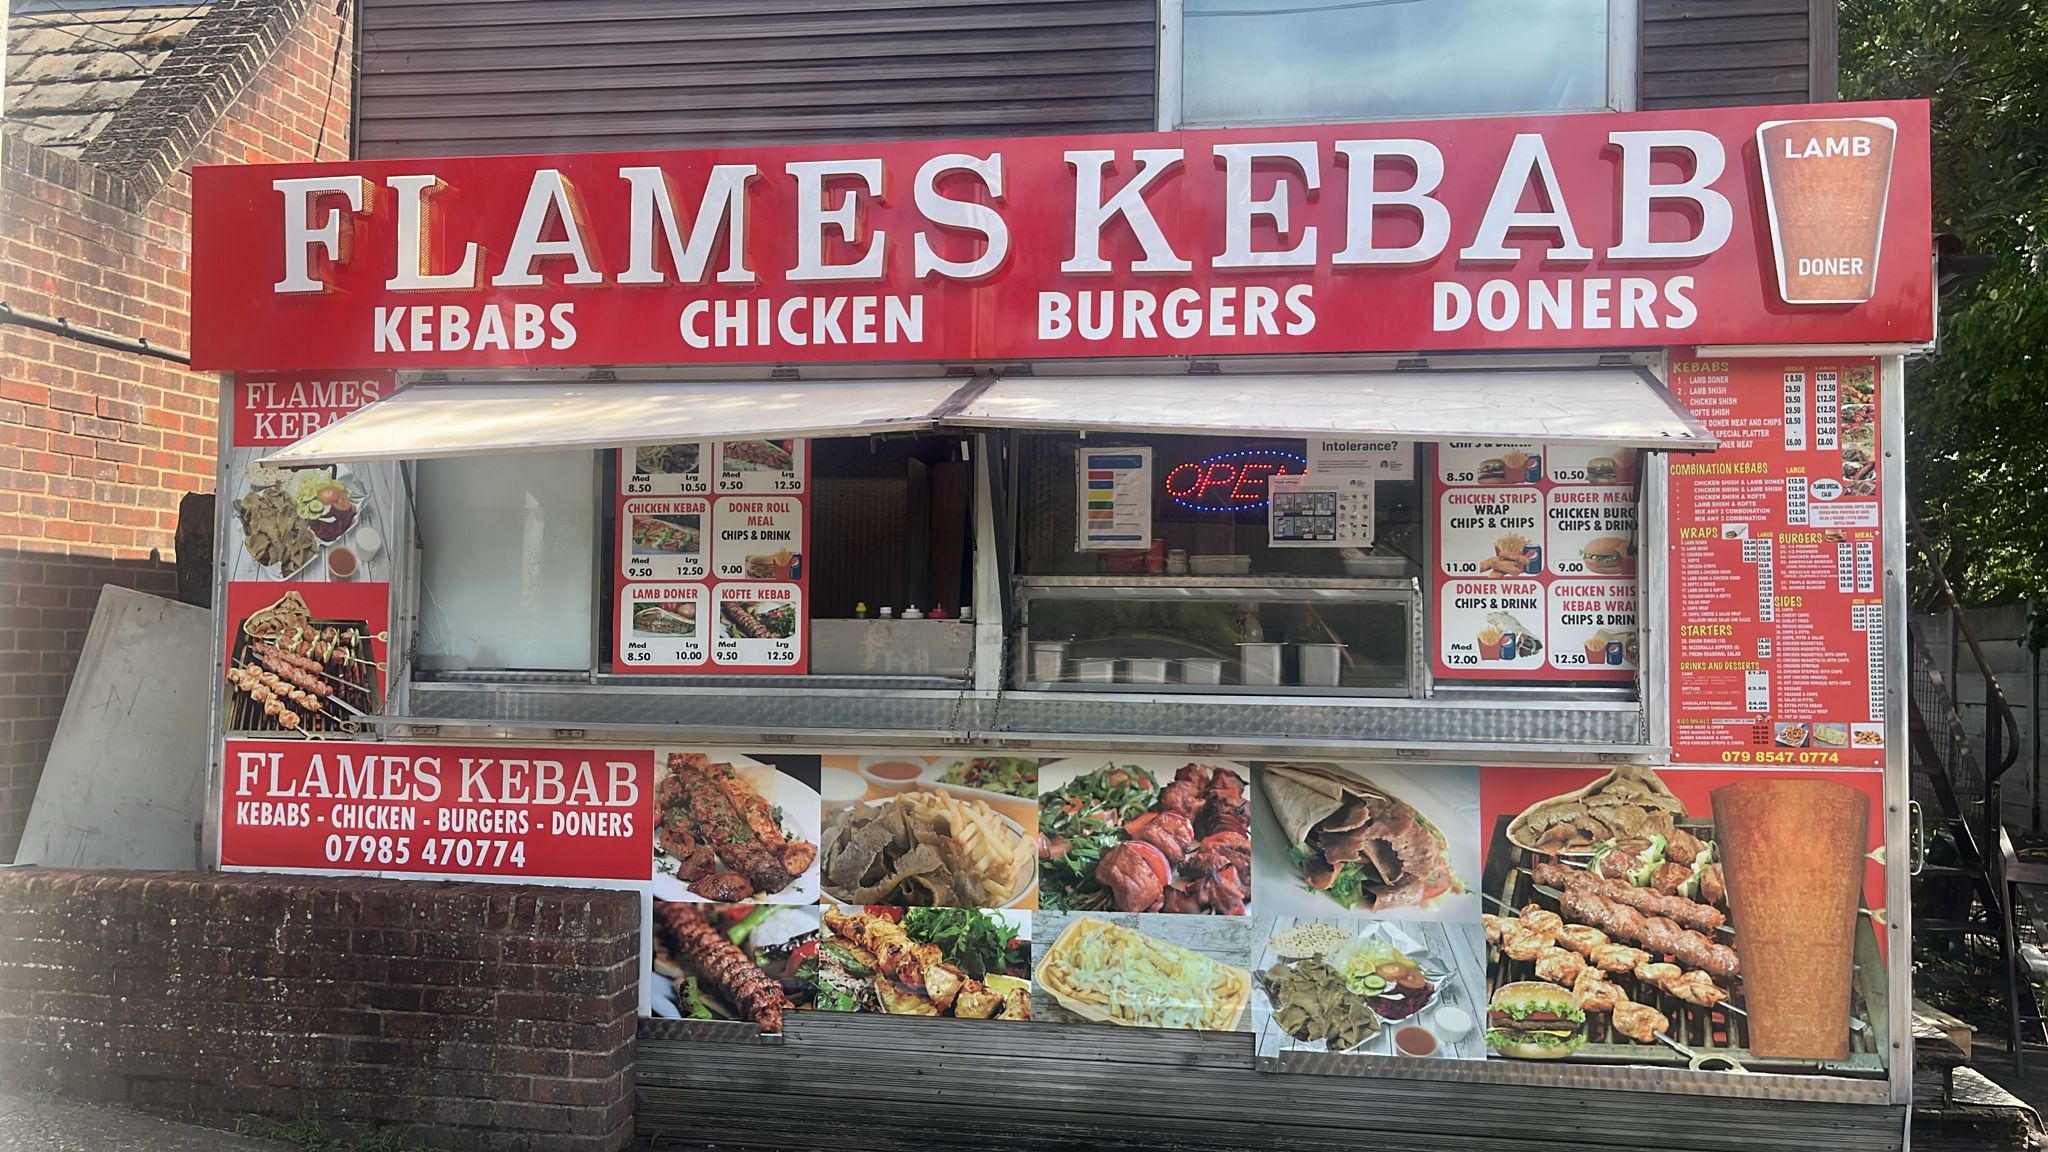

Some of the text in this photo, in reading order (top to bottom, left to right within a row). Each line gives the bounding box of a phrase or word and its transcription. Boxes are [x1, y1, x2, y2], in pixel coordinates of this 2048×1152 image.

[1785, 136, 1871, 159] LAMB
[273, 130, 1735, 295] FLAMES KEBAB
[1798, 258, 1864, 276] DONER
[374, 275, 1698, 353] KEBABS CHICKEN BURGERS DONERS
[1673, 362, 1729, 373] KEBABS
[1689, 376, 1707, 384] LAMB
[1707, 376, 1729, 384] DONER
[1816, 373, 1836, 381] £10.00
[245, 380, 380, 409] FLAMES
[1689, 384, 1836, 395] LAMB SHISH £9.50 £12.50
[1690, 398, 1717, 406] CHICKEN
[1718, 397, 1737, 405] SHISH
[1711, 408, 1730, 416] SHISH
[1785, 406, 1801, 414] £9.50
[1816, 405, 1836, 413] £12.50
[253, 411, 351, 439] KEB
[1708, 419, 1730, 427] DONER
[1748, 418, 1762, 426] AND
[1763, 418, 1782, 426] CHIPS
[1785, 417, 1801, 425] £8.50
[1817, 416, 1836, 424] £10.50
[1716, 430, 1741, 438] SPECIAL
[1817, 427, 1836, 435] £34.00
[1322, 441, 1398, 451] Intolerance?
[781, 470, 795, 478] Lrg
[1670, 462, 1768, 475] COMBINATION KEBABS
[1785, 466, 1806, 474] LARGE
[685, 474, 698, 482] Lrg
[1446, 472, 1474, 482] 8.50
[1553, 471, 1585, 480] 10.50
[628, 482, 706, 492] 8.50 10.50
[719, 480, 801, 490] 9.50 12.50
[1448, 493, 1537, 504] CHICKEN STRIPS
[1554, 492, 1599, 503] BURGER
[628, 503, 706, 513] CHICKEN KEBAB
[728, 502, 790, 513] DONER ROLL
[1474, 504, 1510, 515] WRAP
[1549, 507, 1599, 518] CHICKEN
[747, 516, 774, 526] MEAL
[1450, 517, 1535, 528] CHIPS & CHIPS
[1558, 520, 1591, 531] CHIPS
[1593, 520, 1602, 531] &
[721, 530, 791, 541] CHIPS & DRINK
[1680, 527, 1718, 539] WRAPS
[1779, 533, 1823, 544] BURGERS
[685, 556, 698, 565] Lrg
[628, 567, 703, 577] 9.50 12.50
[721, 565, 743, 574] 9.00
[1446, 563, 1476, 572] 11.00
[1558, 563, 1583, 572] 9.00
[632, 589, 698, 599] LAMB DONER
[722, 589, 791, 600] KOFTE KEBAB
[1456, 583, 1537, 595] DONER WRAP
[1554, 585, 1605, 597] CHICKEN
[1455, 598, 1537, 609] CHIPS & DRINK
[1563, 601, 1601, 612] KEBAB
[1774, 596, 1802, 607] SIDES
[1561, 614, 1593, 625] CHIPS
[1596, 614, 1604, 625] &
[1680, 624, 1733, 636] STARTERS
[628, 641, 699, 649] Med Lrg
[776, 640, 789, 649] Lrg
[627, 651, 702, 661] 8.50 10.00
[716, 651, 794, 660] 9.50 12.50
[1447, 655, 1478, 664] 12.00
[1554, 654, 1585, 664] 12.50
[1680, 661, 1760, 670] DRINKS AND DESSERTS
[1721, 751, 1839, 763] 079 8547 0774
[236, 752, 640, 807] FLAMES KEBAB
[236, 802, 310, 828] KEBABS
[331, 804, 416, 831] CHICKEN
[438, 807, 530, 834] BURGERS
[552, 811, 633, 838] DONERS
[325, 834, 526, 868] 07985 470774
